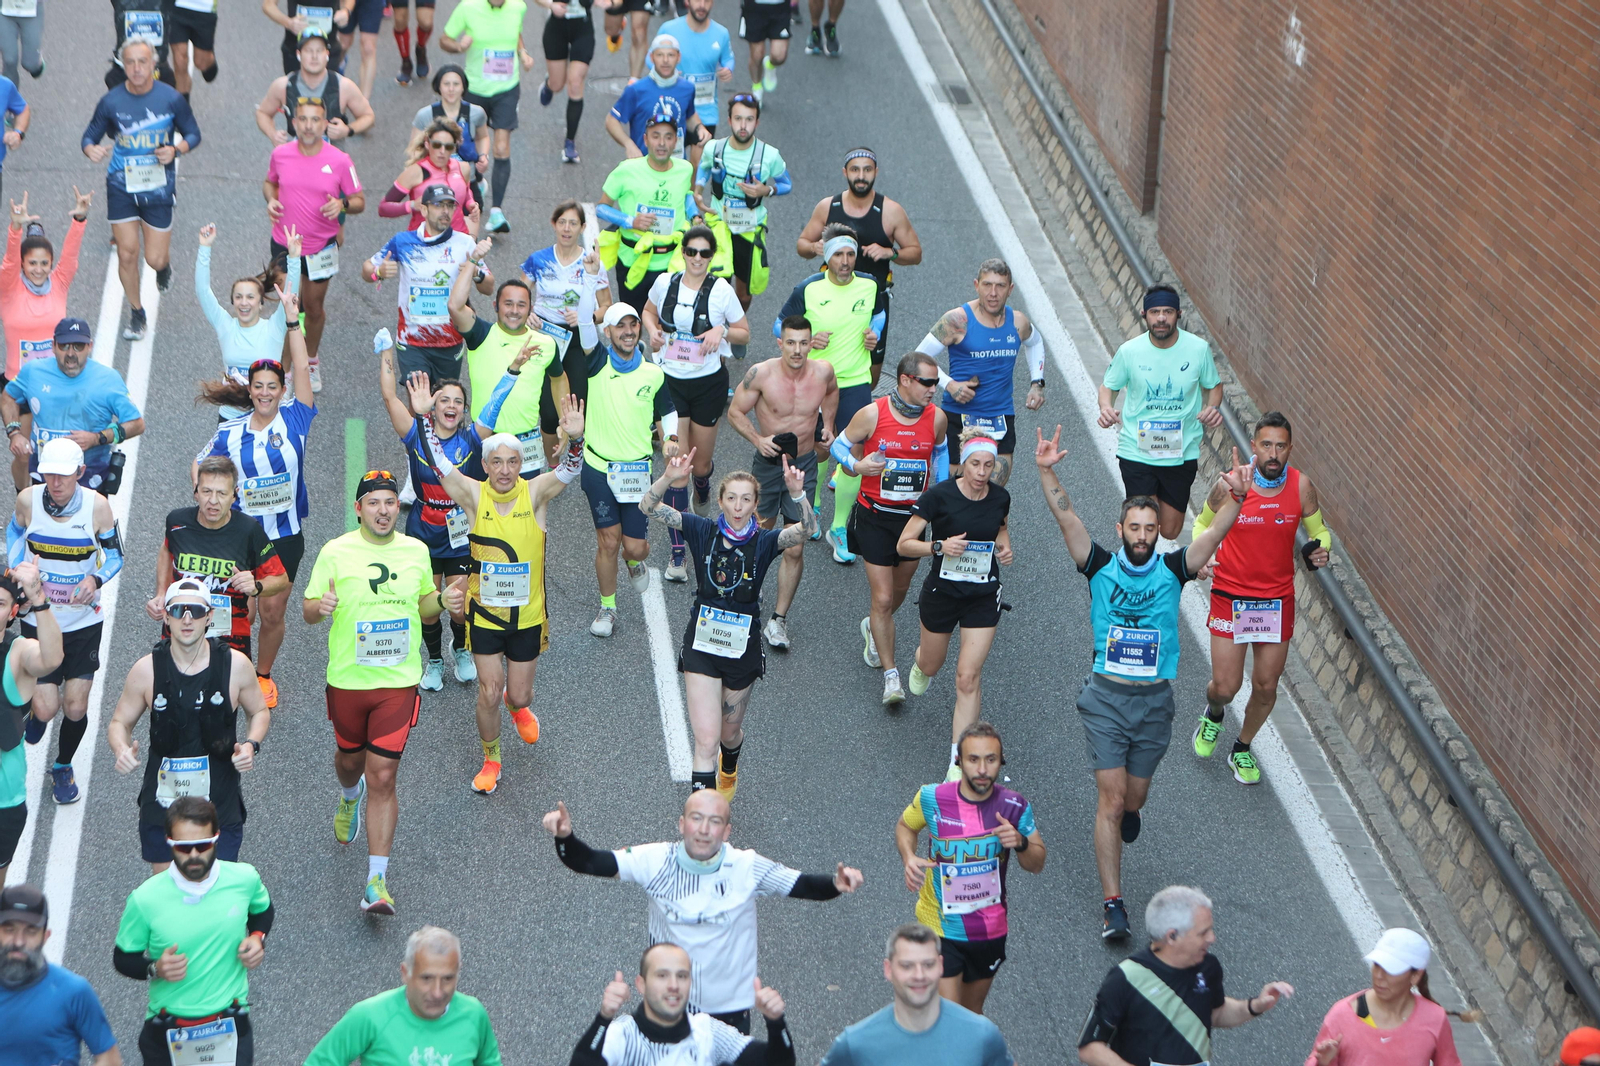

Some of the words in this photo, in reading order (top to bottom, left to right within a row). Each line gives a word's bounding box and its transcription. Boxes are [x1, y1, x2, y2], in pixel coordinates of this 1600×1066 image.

[649, 208, 670, 216] ZURICH
[545, 325, 566, 337] ZURICH
[259, 478, 285, 486] ZURICH
[272, 496, 291, 505] CABEZA
[180, 557, 234, 576] LERUS
[716, 615, 744, 624] ZURICH
[376, 622, 403, 630] ZURICH
[712, 628, 732, 637] 10759
[1126, 633, 1153, 641] ZURICH
[1122, 647, 1142, 656] 11552
[172, 762, 202, 770] ZURICH
[961, 864, 992, 875] ZURICH
[955, 891, 990, 901] PEPEBATEN
[192, 1024, 226, 1038] ZURICH
[195, 1043, 215, 1053] 9925
